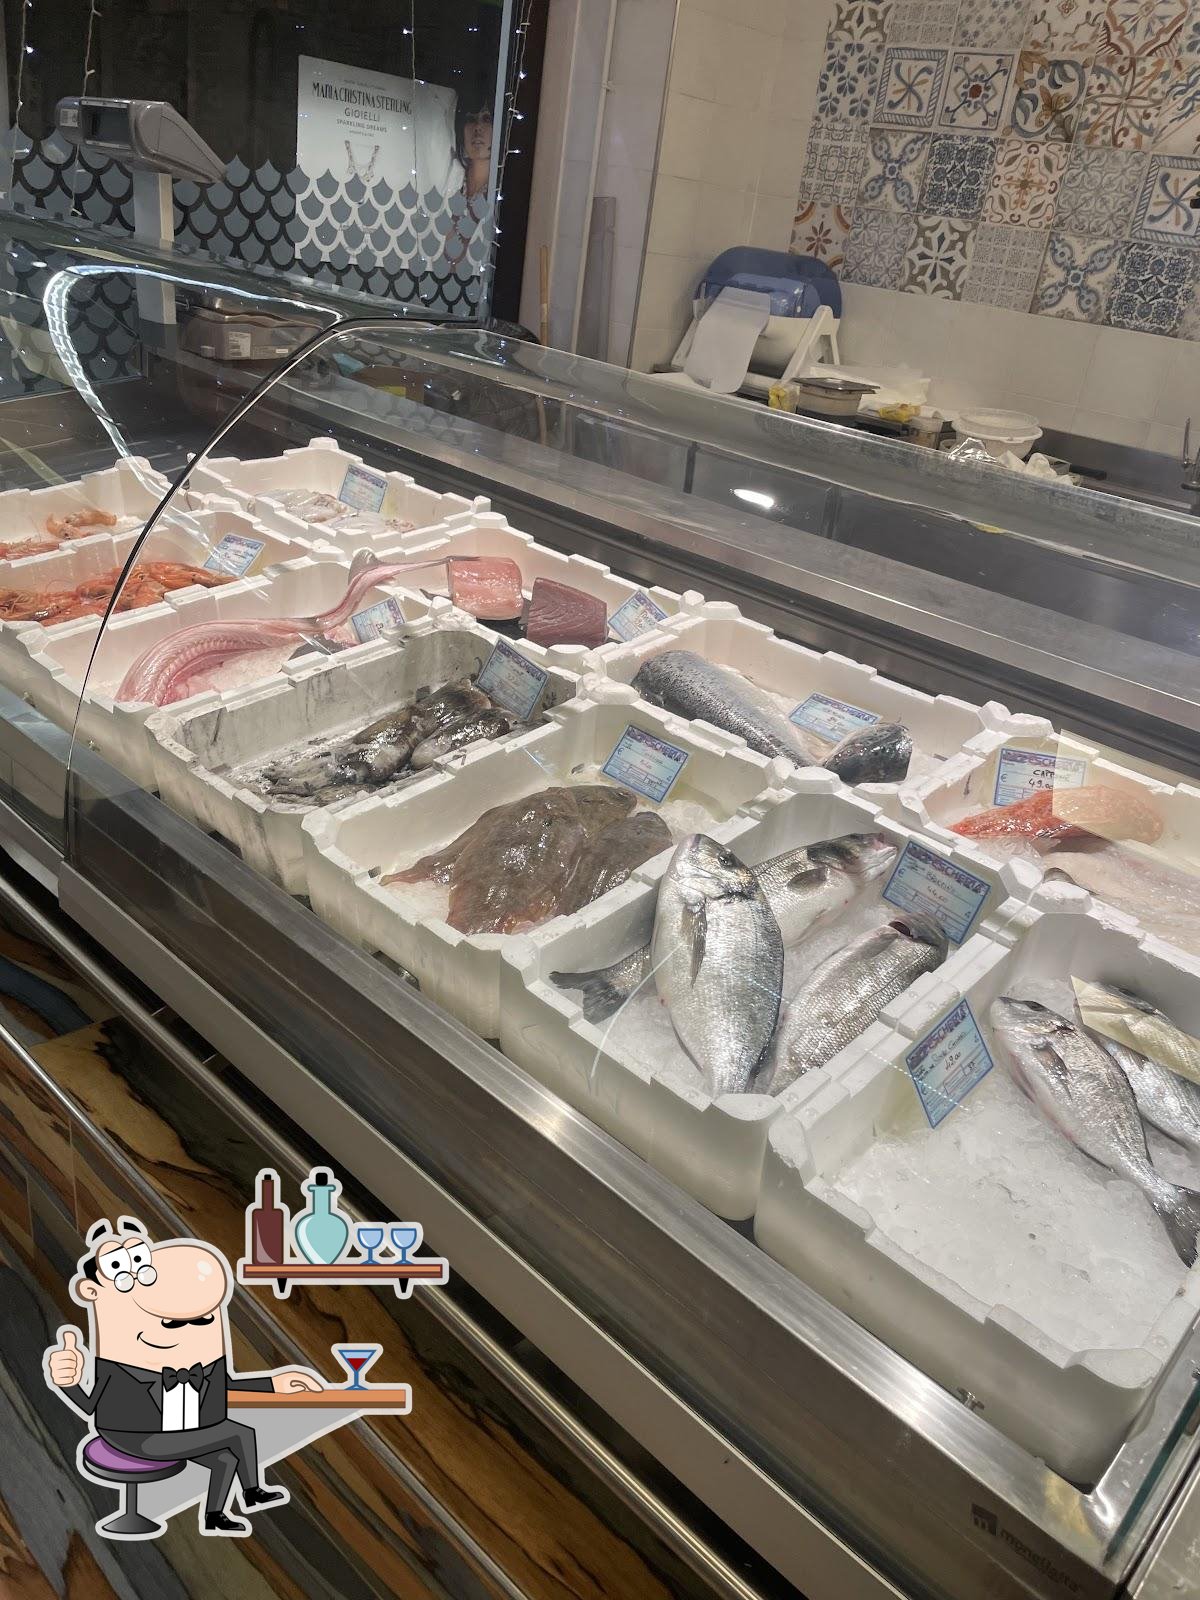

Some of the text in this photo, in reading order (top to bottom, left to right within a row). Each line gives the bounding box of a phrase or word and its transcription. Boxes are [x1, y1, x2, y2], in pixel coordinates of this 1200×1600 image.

[312, 82, 339, 101] MARIA
[340, 87, 376, 109] CRISTINA
[376, 95, 412, 116] STERLING
[344, 107, 381, 122] GIOIELLI
